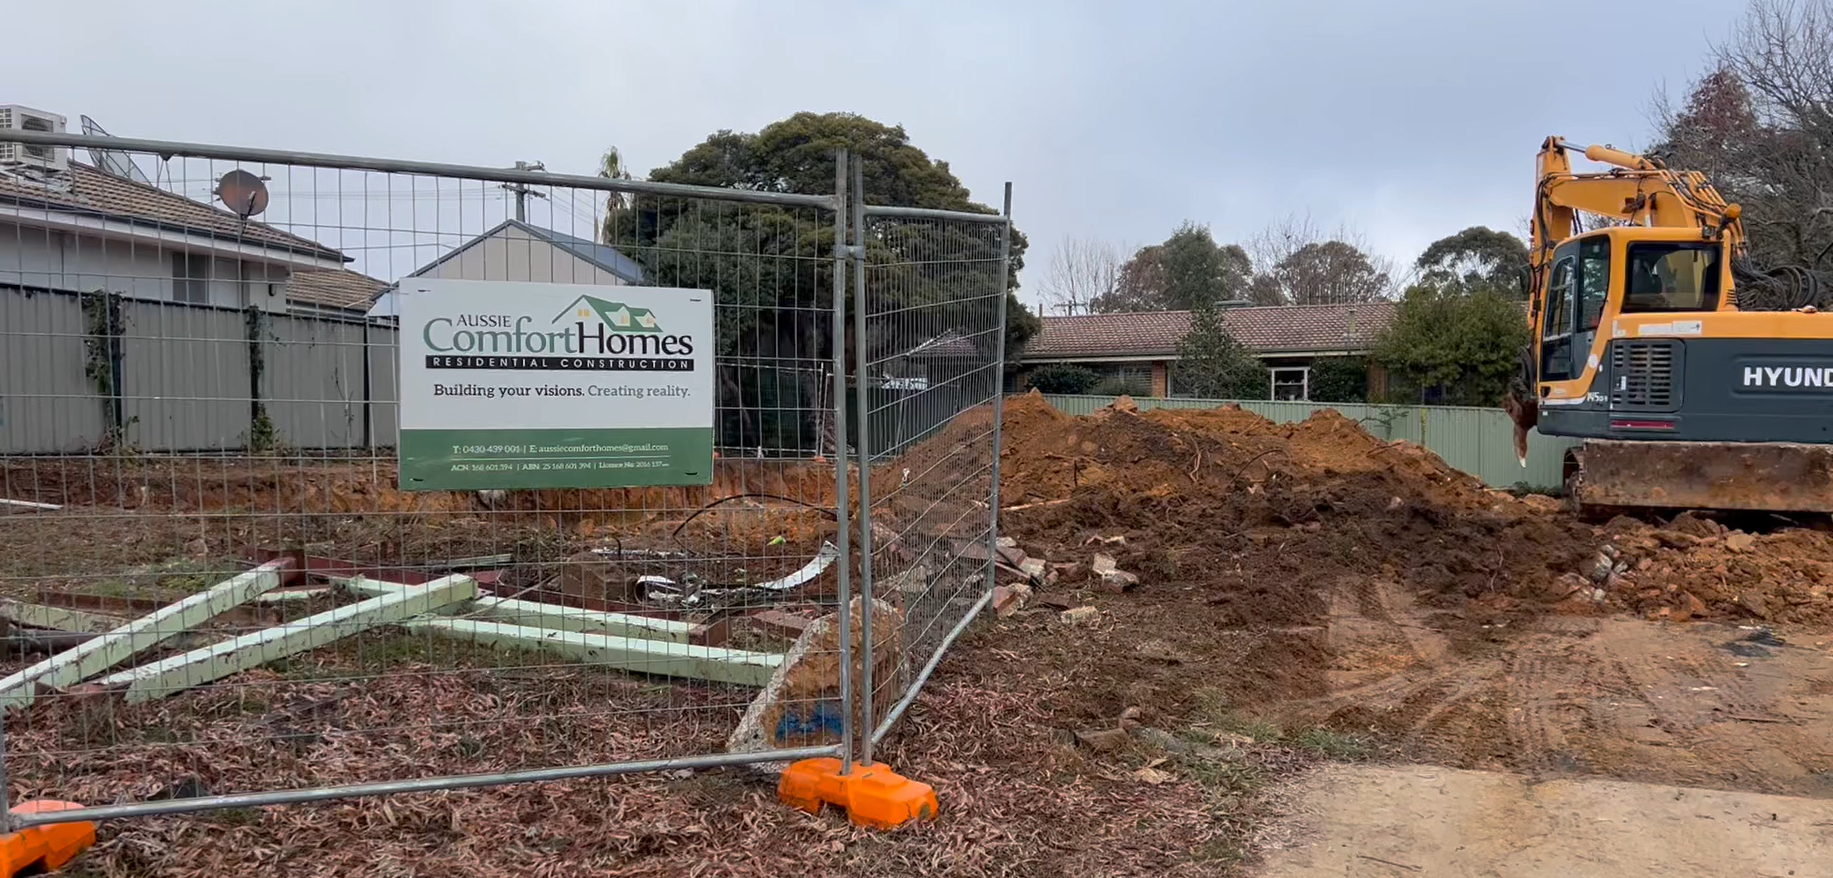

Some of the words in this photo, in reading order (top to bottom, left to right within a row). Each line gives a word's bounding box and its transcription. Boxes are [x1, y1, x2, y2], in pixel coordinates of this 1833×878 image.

[457, 314, 512, 327] AUSSIE
[433, 357, 548, 367] RESIDENTIAL
[560, 358, 688, 369] CONSTRUCTION
[433, 384, 495, 398] Building
[499, 386, 531, 398] your
[535, 385, 585, 396] visions.
[588, 384, 644, 398] Creating
[646, 385, 691, 398] reality.
[453, 445, 462, 454] T:
[463, 445, 486, 454] 0430
[487, 445, 504, 454] 439
[504, 445, 520, 453] 001
[539, 443, 669, 453] aussiecomforthomes@gmail.com
